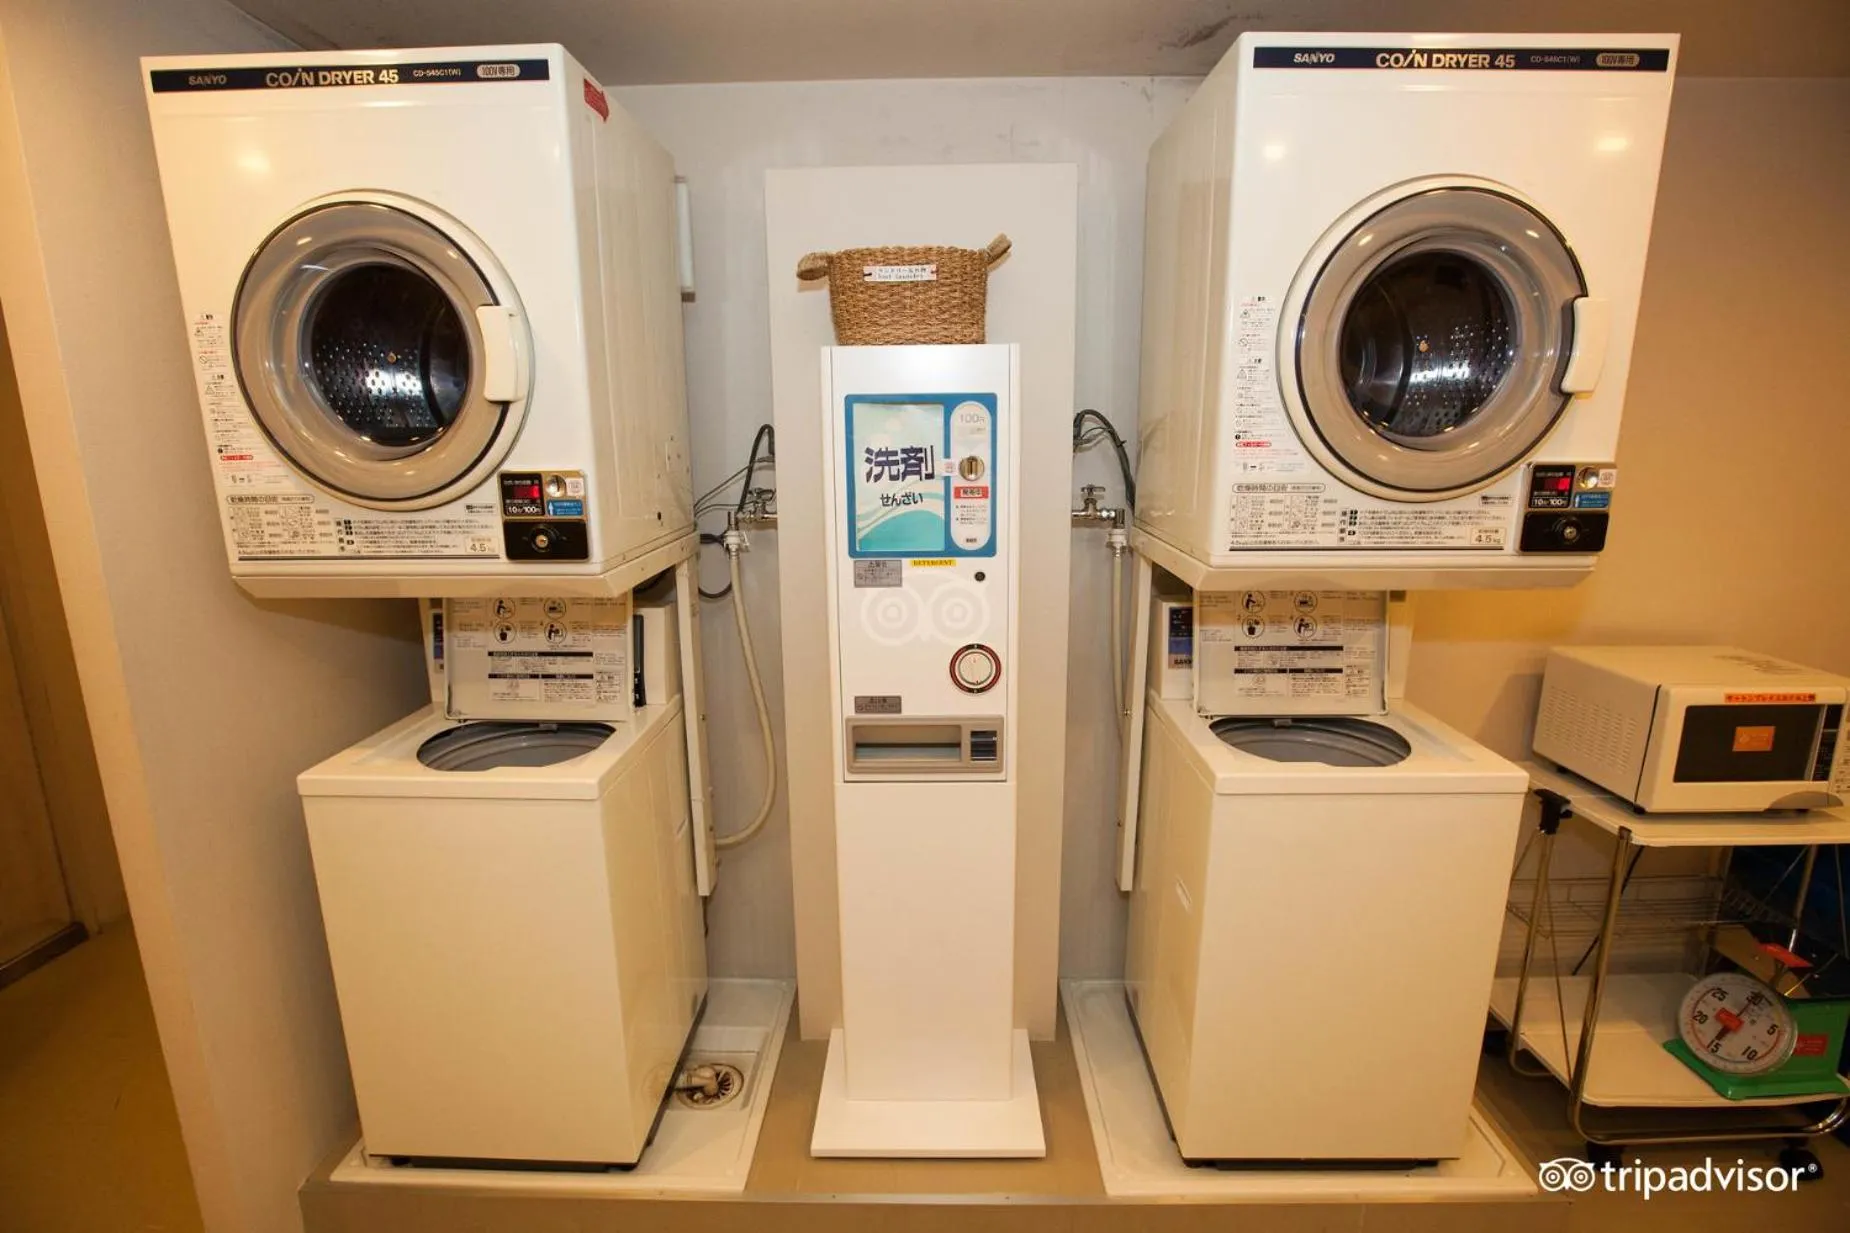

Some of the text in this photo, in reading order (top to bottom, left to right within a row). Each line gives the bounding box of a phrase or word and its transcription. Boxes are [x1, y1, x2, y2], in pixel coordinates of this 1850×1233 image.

[1294, 52, 1335, 65] SANYO
[1431, 53, 1490, 68] DRYER
[1494, 54, 1516, 68] 45
[188, 74, 227, 86] SANYO
[318, 70, 375, 86] DRYER
[379, 69, 400, 84] 45
[864, 445, 935, 483] 洗剤
[880, 491, 924, 508] せんざい
[1711, 987, 1729, 1001] 25
[1692, 1010, 1709, 1024] 20
[1767, 1024, 1779, 1036] 5
[1706, 1038, 1722, 1053] 15
[1742, 1046, 1758, 1060] 10
